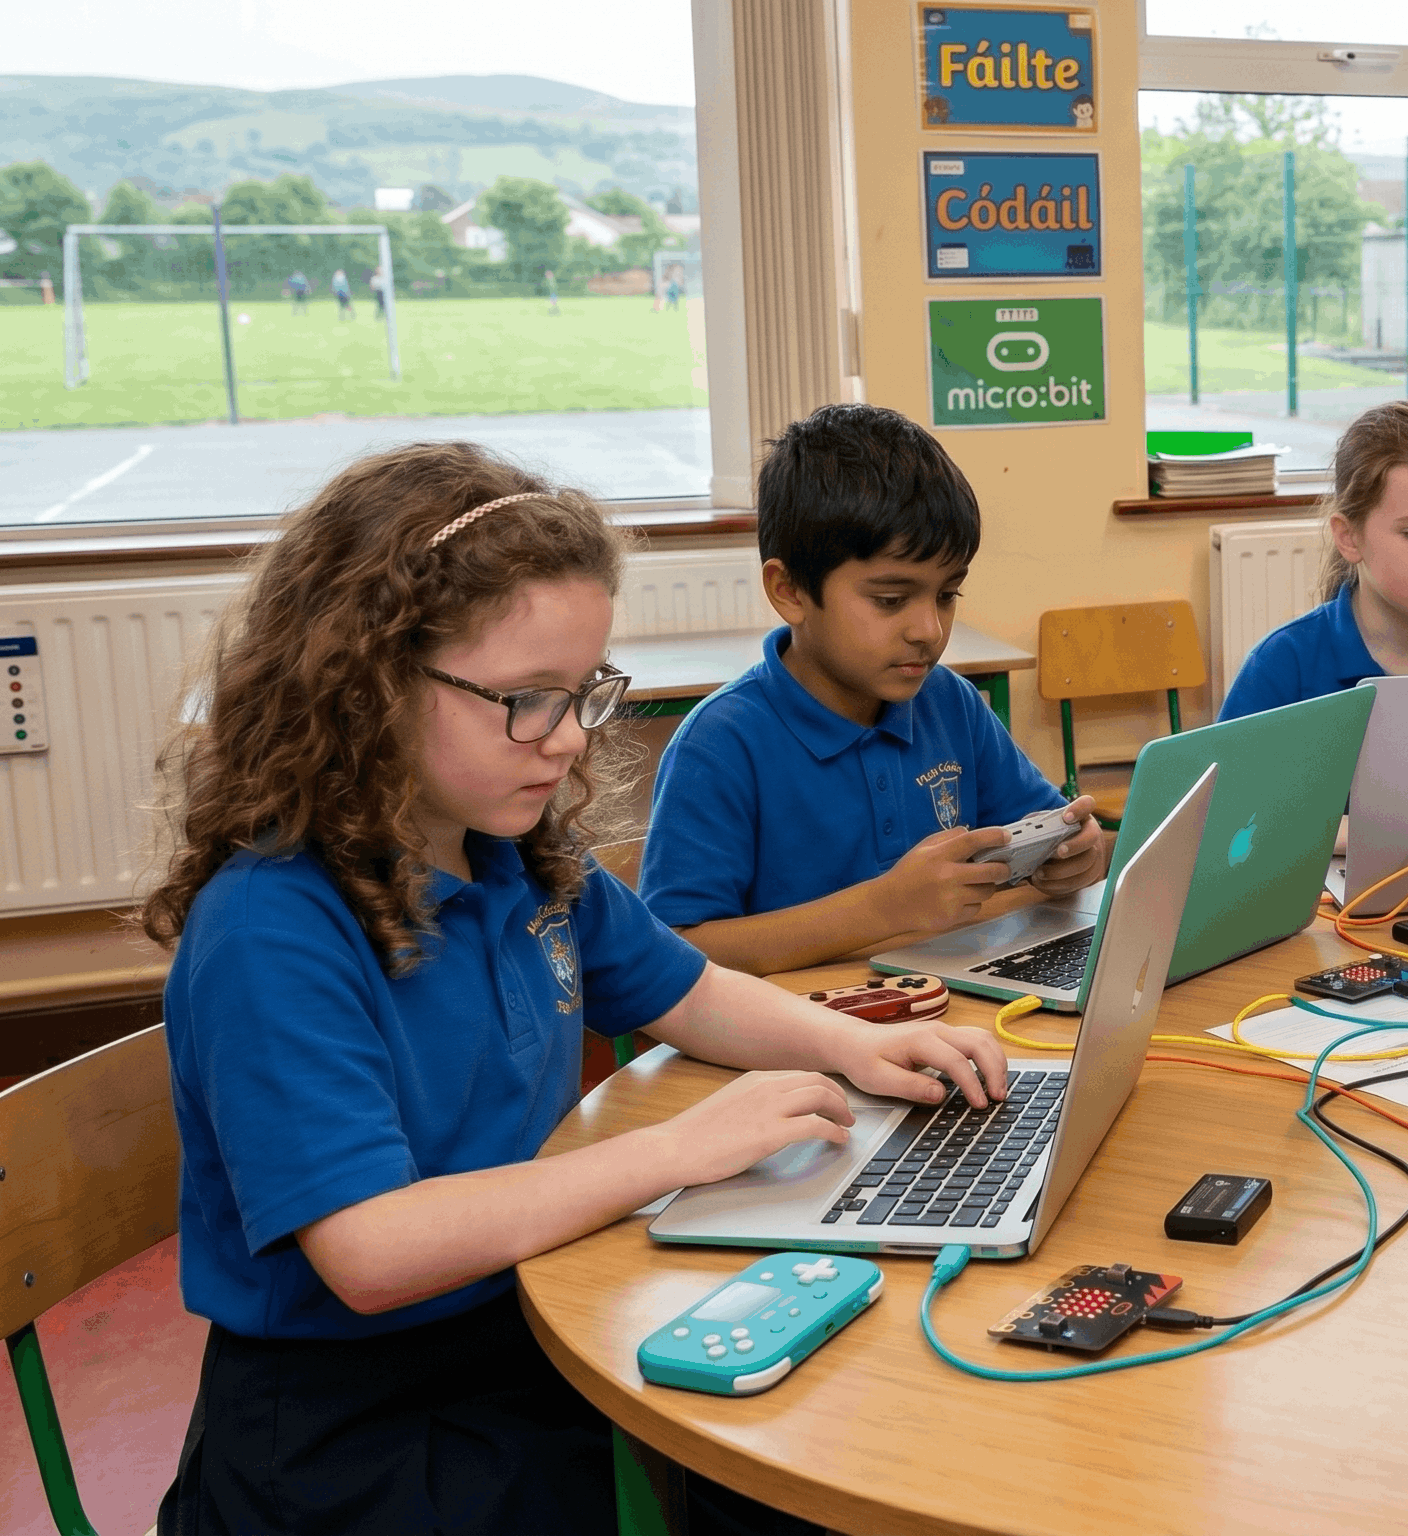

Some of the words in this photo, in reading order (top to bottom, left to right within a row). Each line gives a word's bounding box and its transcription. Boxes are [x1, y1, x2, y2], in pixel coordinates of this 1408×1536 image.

[939, 40, 1080, 90] Fáilte
[936, 184, 1093, 231] Códáil
[947, 376, 1093, 411] micro:bit
